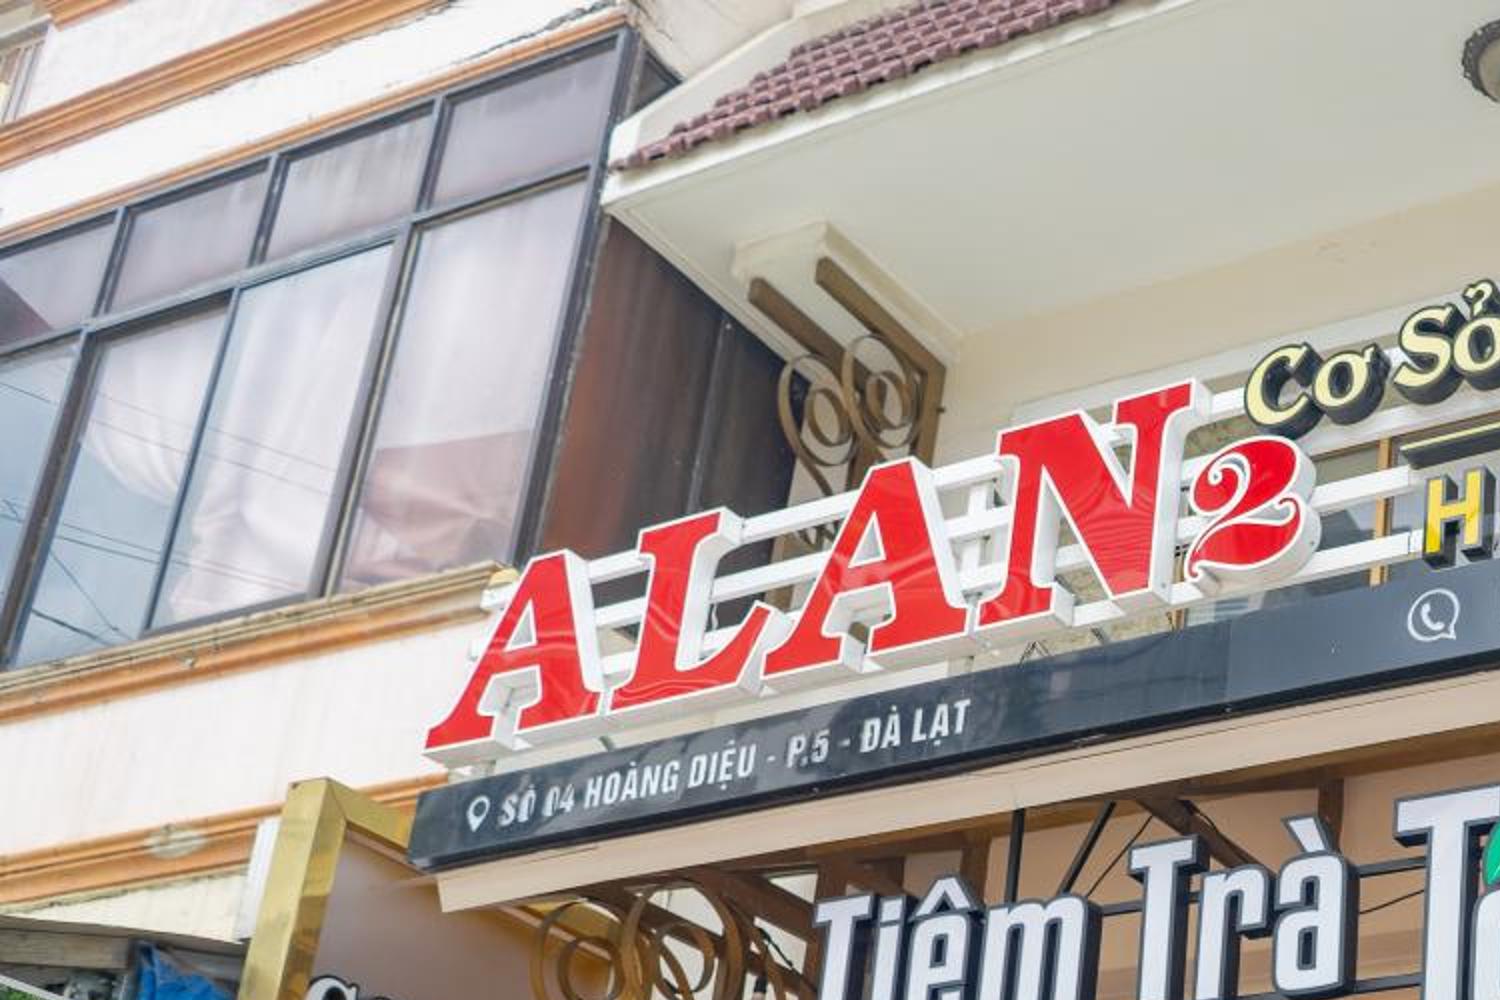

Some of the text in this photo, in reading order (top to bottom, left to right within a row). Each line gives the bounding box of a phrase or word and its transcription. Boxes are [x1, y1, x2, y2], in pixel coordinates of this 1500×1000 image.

[1244, 345, 1382, 432] Cơ
[424, 378, 1198, 751] ALAN
[584, 760, 678, 808] HOÀNG
[688, 741, 756, 791] DIỆU
[786, 730, 828, 768] P.5
[861, 715, 900, 753] ĐÀ
[912, 699, 971, 750] LẠT
